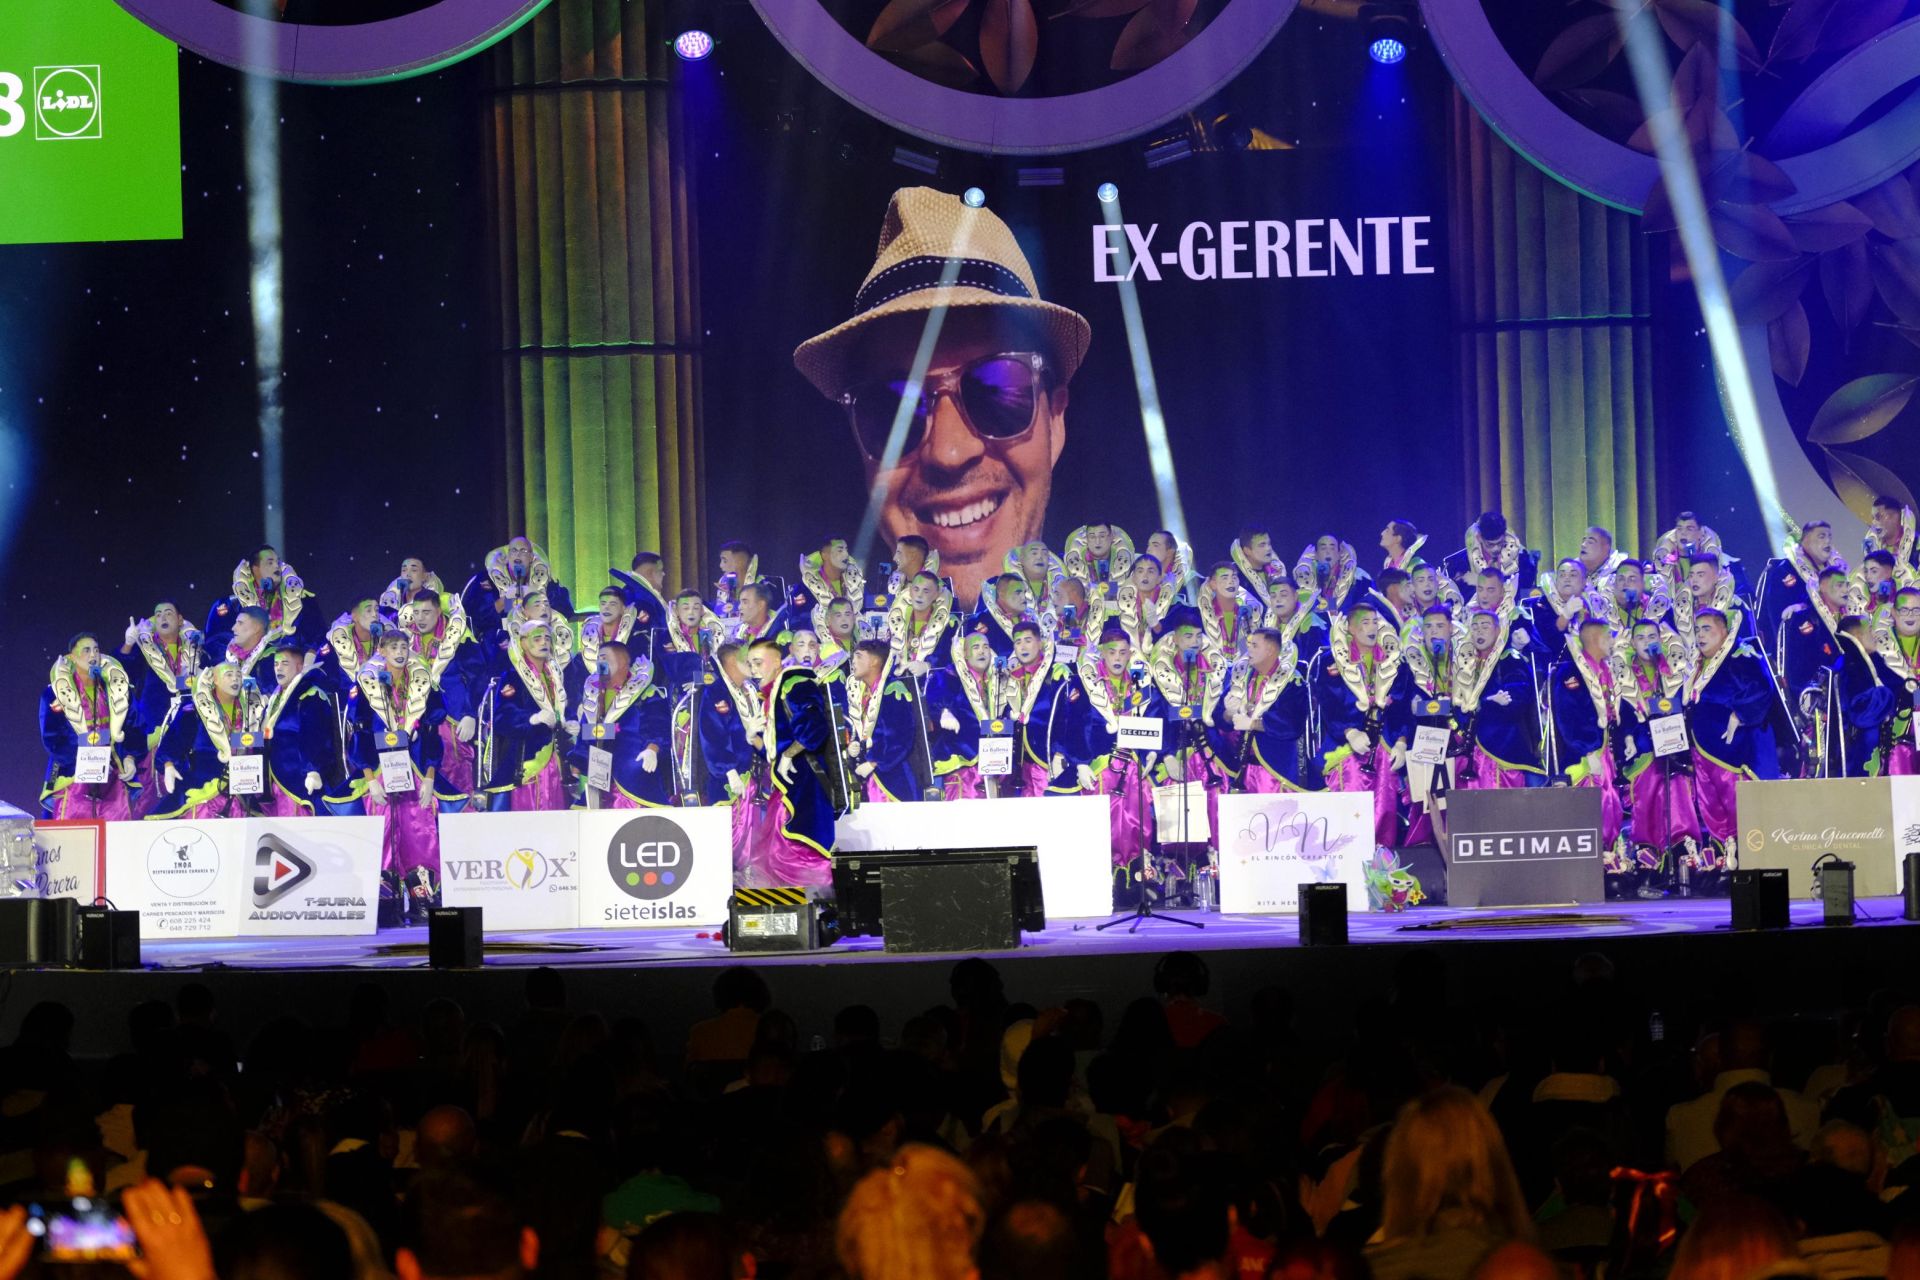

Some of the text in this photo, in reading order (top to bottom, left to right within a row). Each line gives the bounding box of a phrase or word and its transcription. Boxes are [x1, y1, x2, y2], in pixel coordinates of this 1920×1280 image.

[1093, 216, 1435, 283] EX-GERENTE
[1121, 729, 1159, 737] DECIMAS
[1458, 835, 1592, 857] DECIMAS
[1771, 827, 1886, 848] Karina Giacomelli
[620, 842, 681, 868] LED
[304, 897, 367, 906] T-SUENA
[604, 902, 697, 921] sieteislas
[248, 911, 366, 921] AUDIOVISUALES
